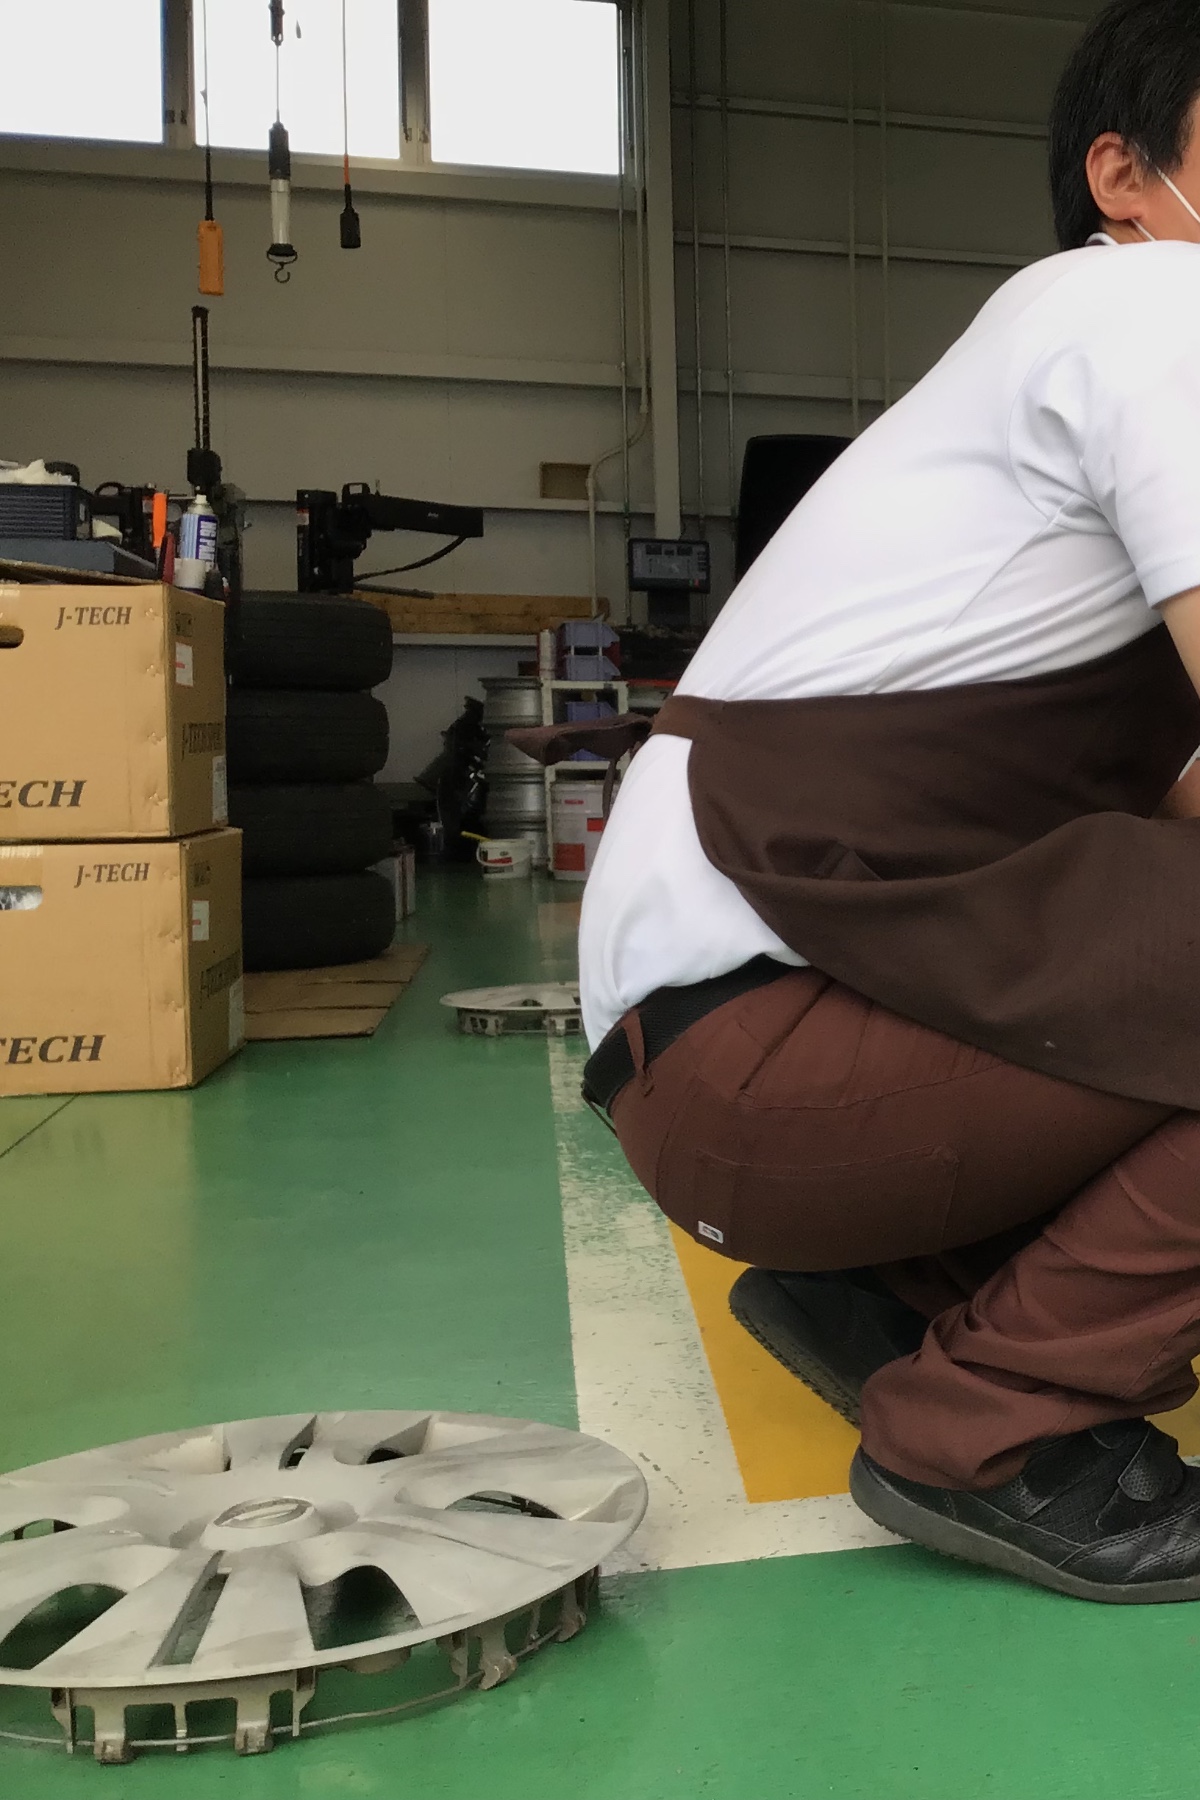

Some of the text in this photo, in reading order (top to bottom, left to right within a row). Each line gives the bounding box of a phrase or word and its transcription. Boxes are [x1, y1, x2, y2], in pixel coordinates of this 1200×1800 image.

[55, 606, 132, 630] J-TECH
[74, 862, 150, 888] J-TECH
[0, 1034, 107, 1065] ECH
